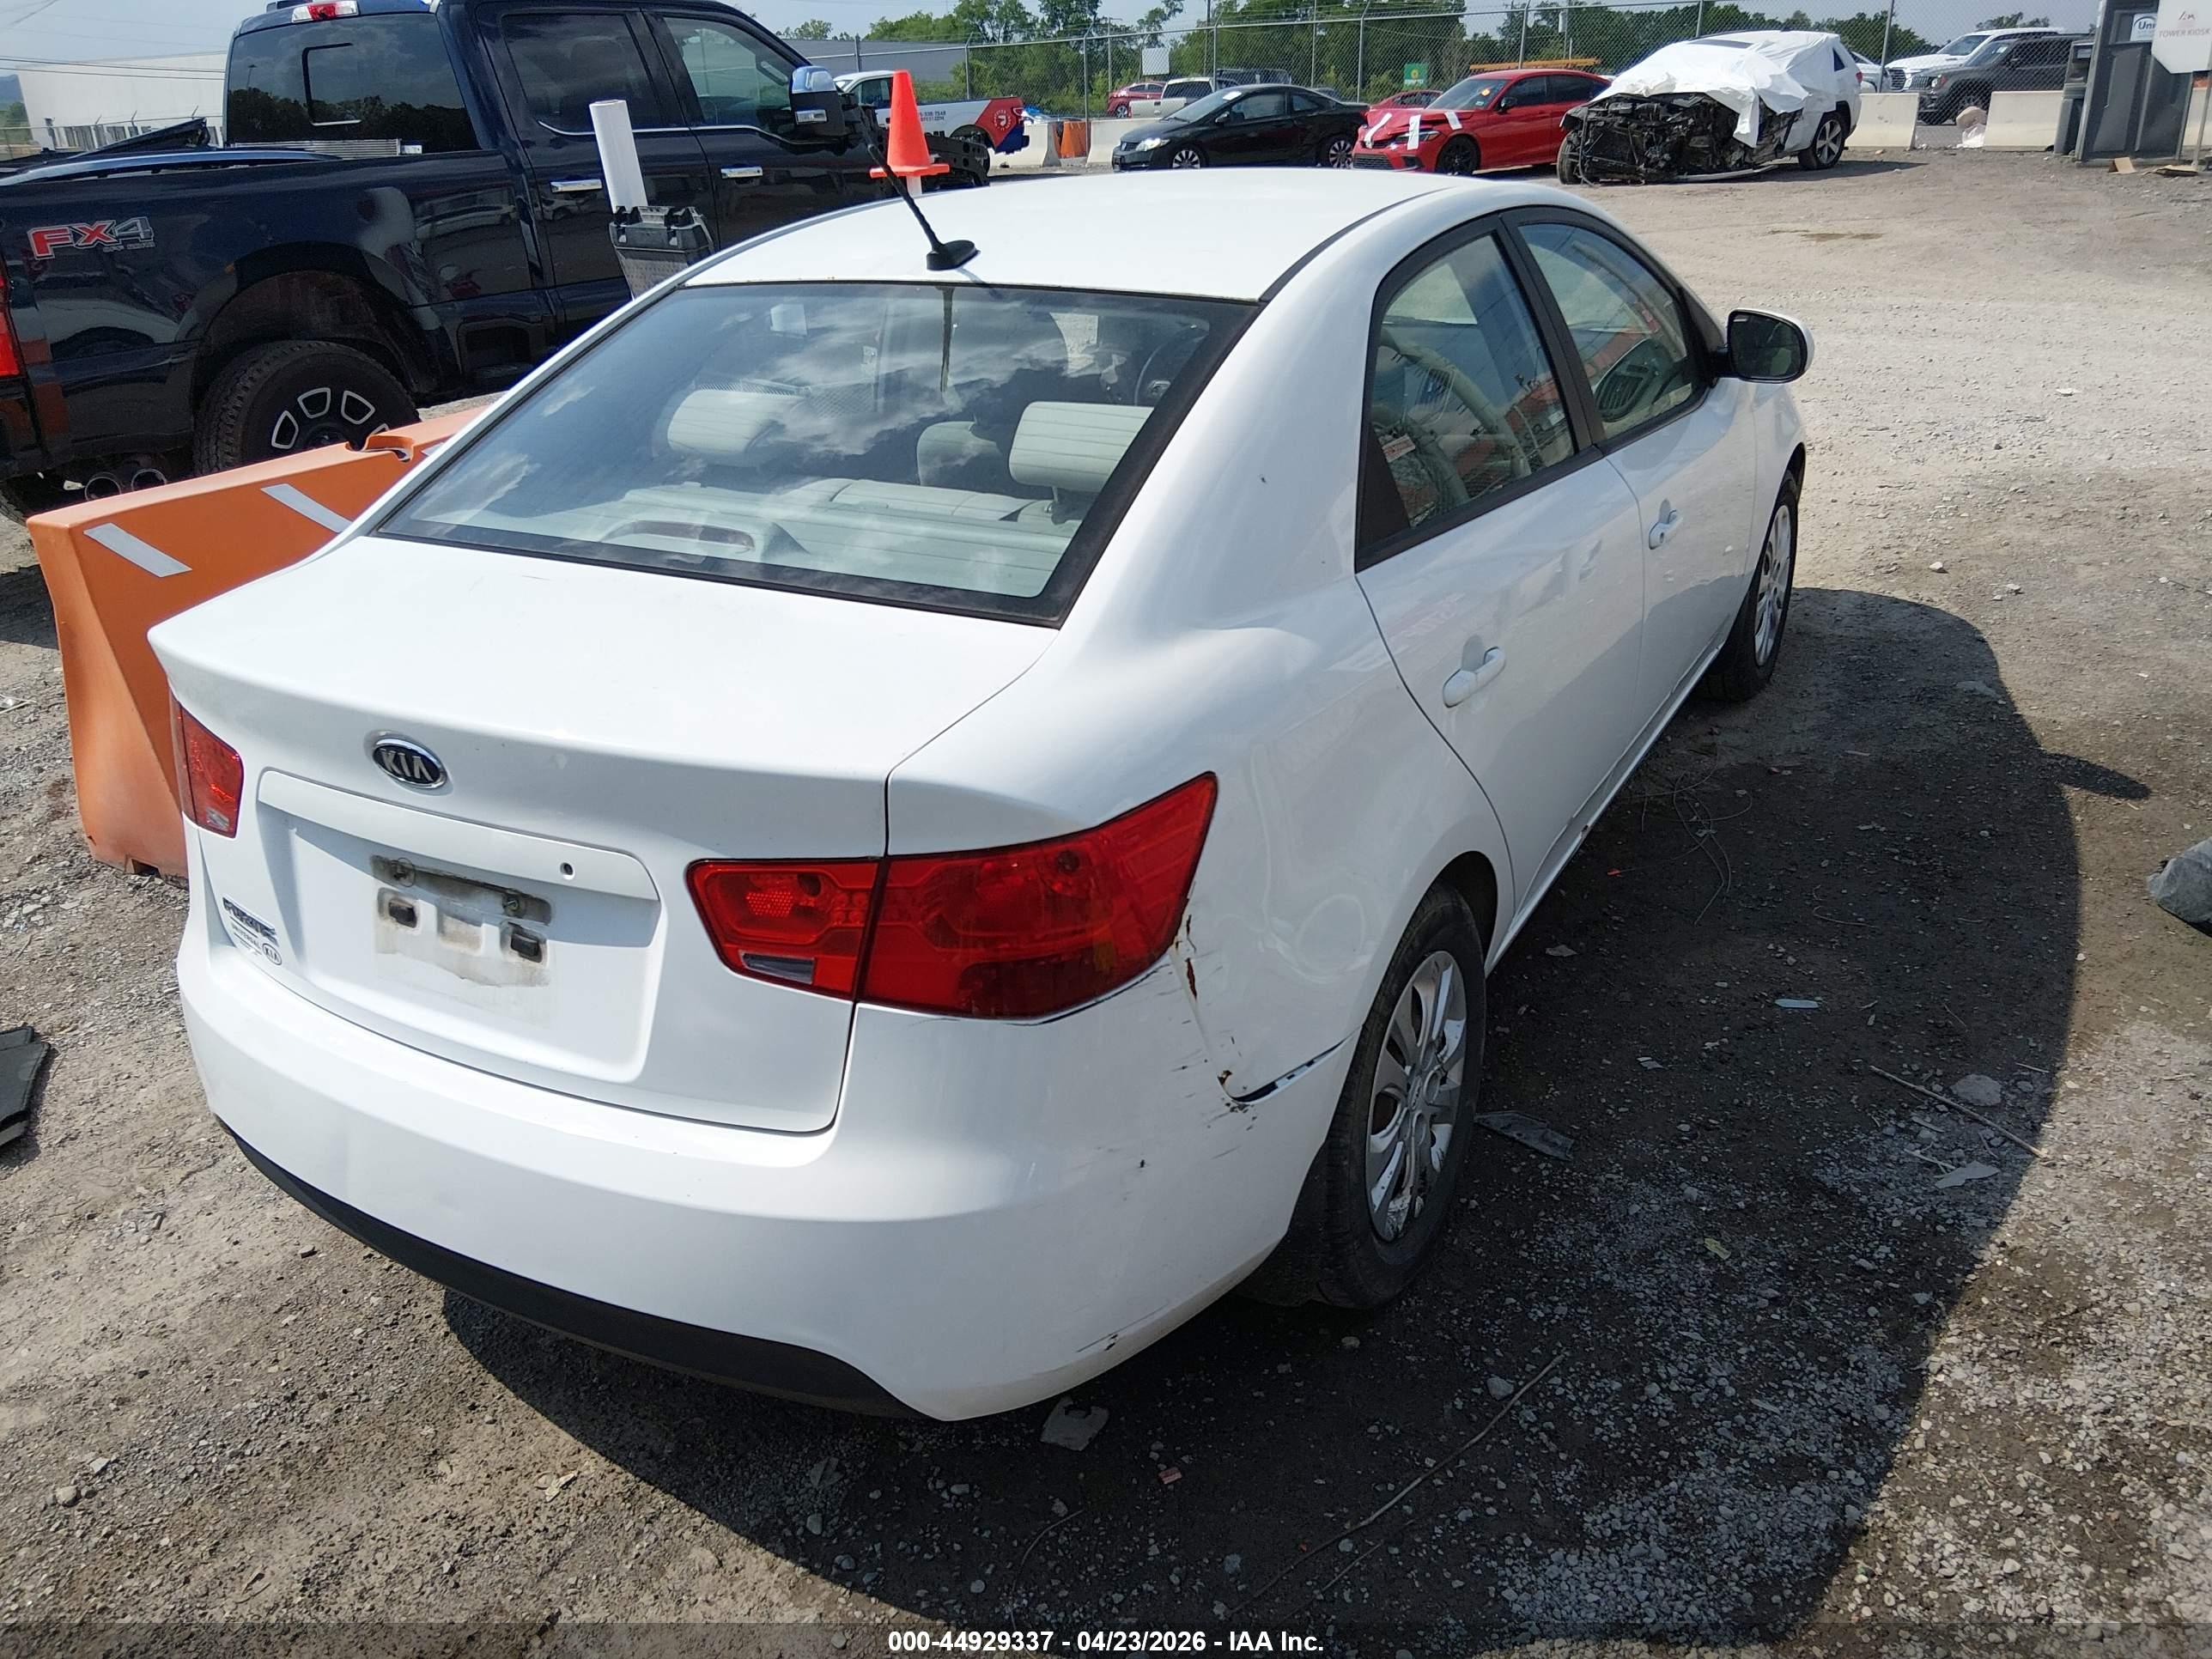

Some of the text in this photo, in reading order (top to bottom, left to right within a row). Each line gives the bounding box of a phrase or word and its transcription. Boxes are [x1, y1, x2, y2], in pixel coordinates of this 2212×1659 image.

[2159, 27, 2212, 39] TOWER KIOSK
[27, 216, 155, 260] FX4
[379, 747, 434, 782] KIA
[264, 945, 280, 963] KIA
